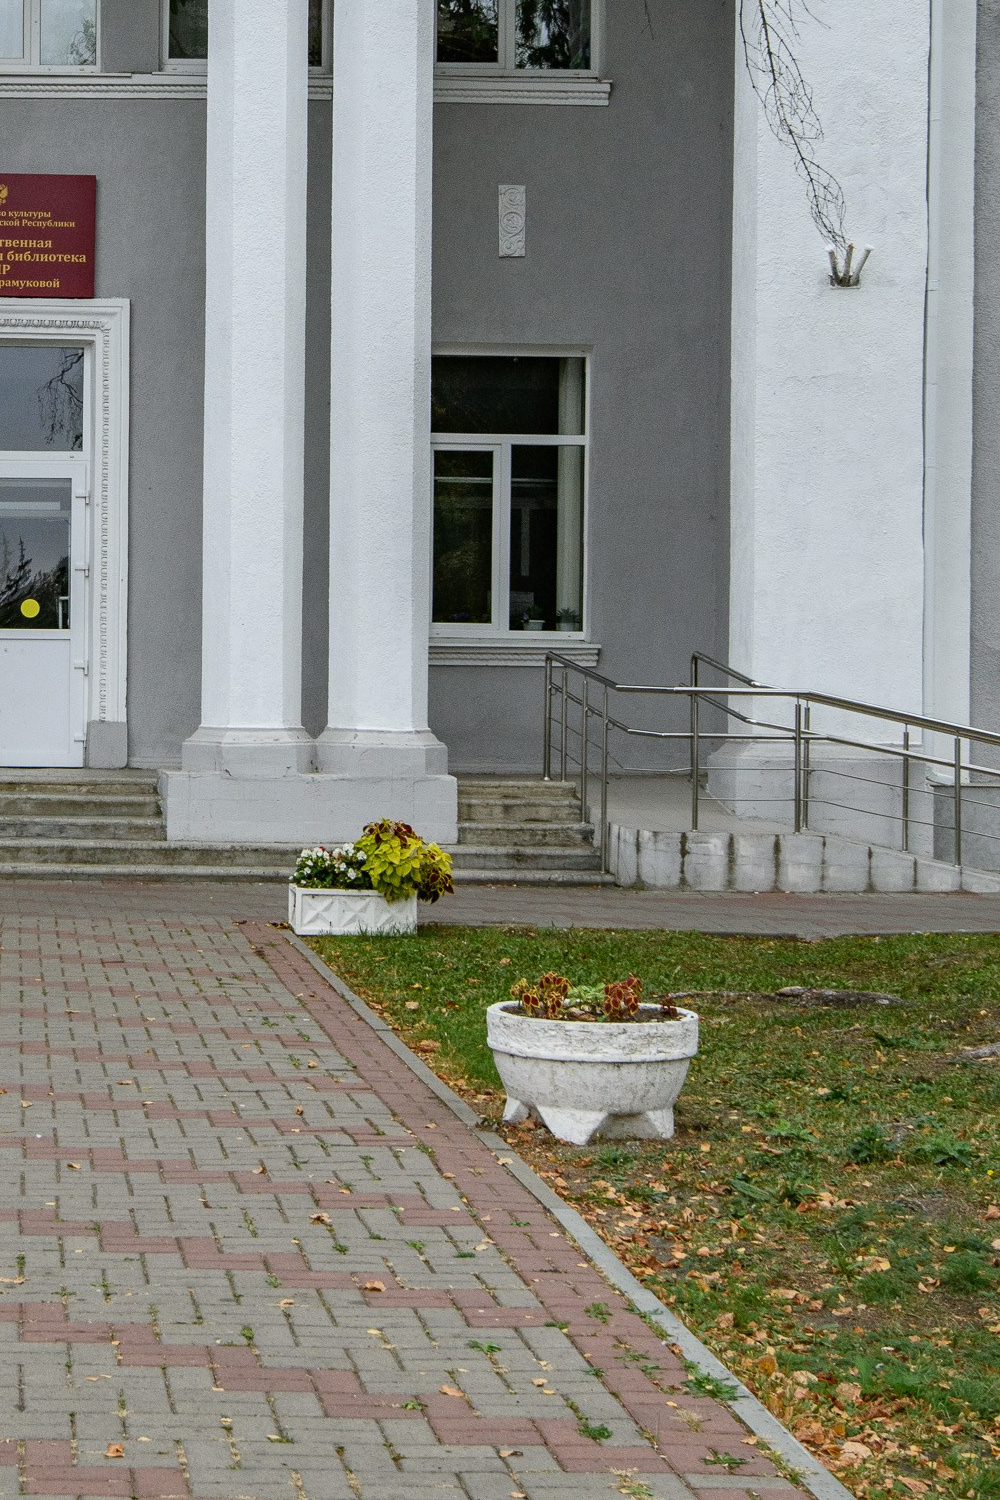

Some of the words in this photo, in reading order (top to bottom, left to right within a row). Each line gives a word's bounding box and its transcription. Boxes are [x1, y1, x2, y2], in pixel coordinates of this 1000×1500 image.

[8, 209, 51, 218] культуры
[22, 220, 76, 228] Республики
[7, 250, 86, 262] библиотека
